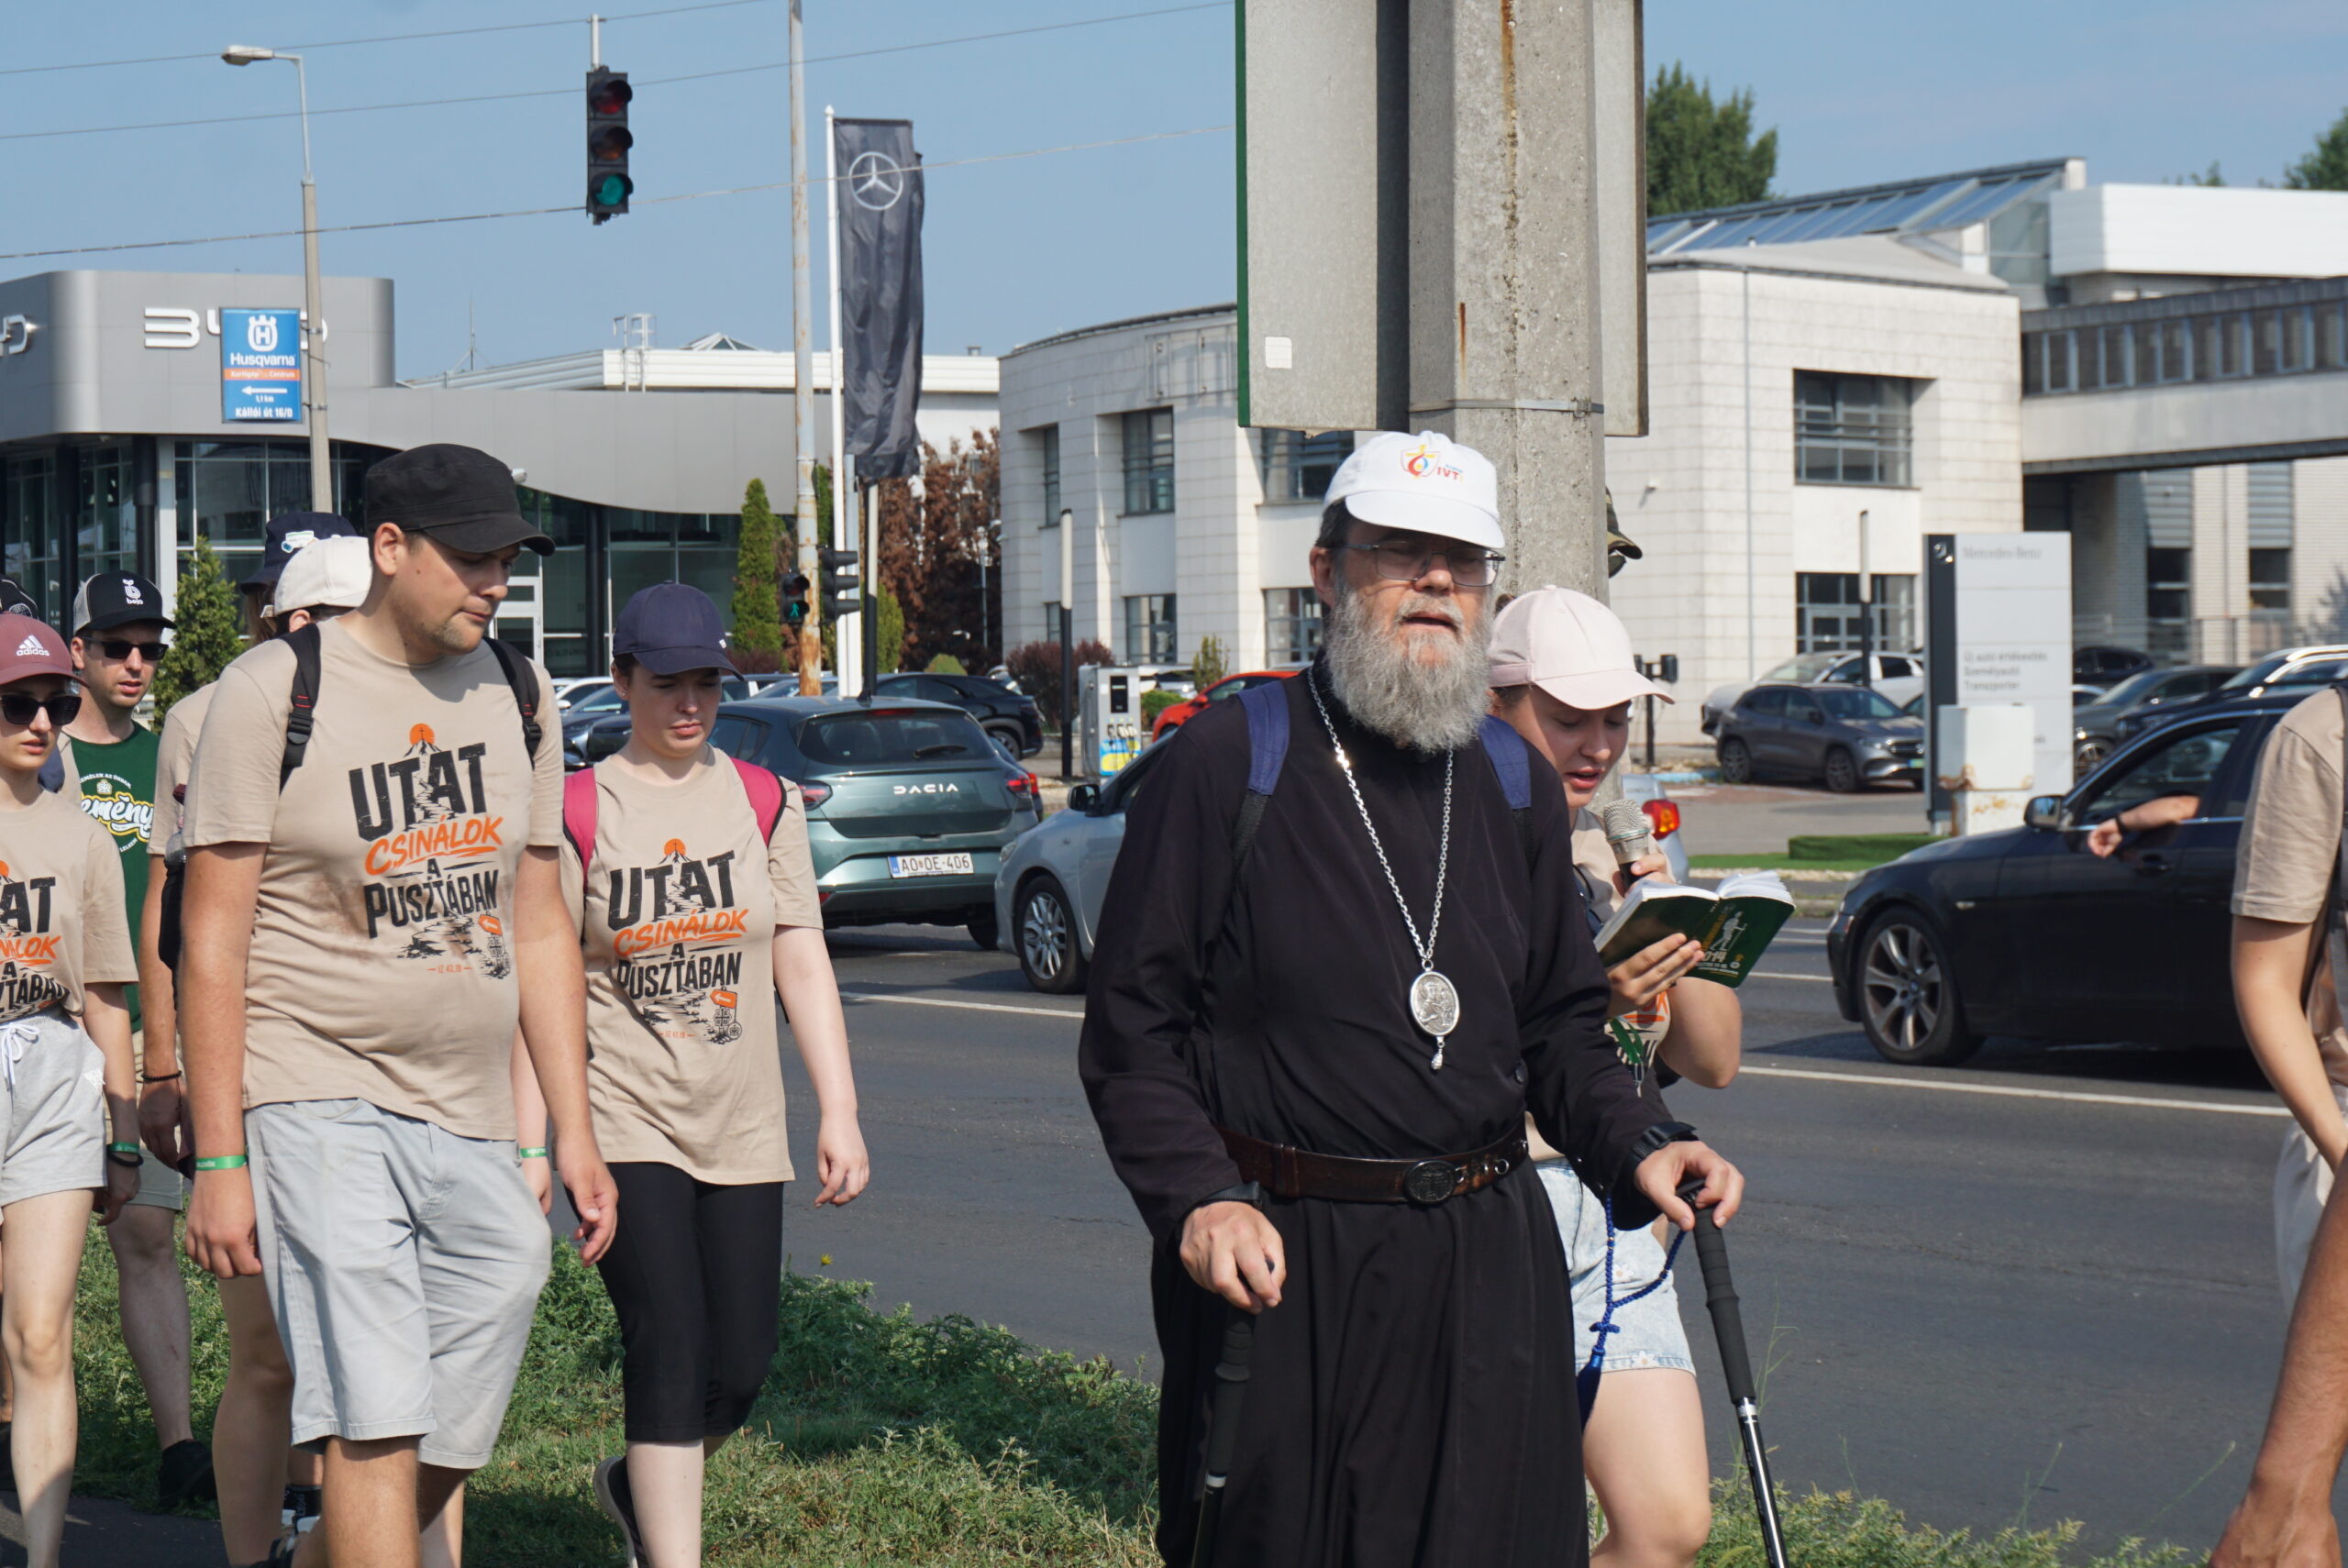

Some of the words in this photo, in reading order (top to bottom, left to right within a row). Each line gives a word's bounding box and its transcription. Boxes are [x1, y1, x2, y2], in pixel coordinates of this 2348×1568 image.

[230, 352, 295, 367] Husqvarna
[17, 647, 50, 657] adidas
[349, 742, 487, 842] UTAT
[893, 782, 958, 795] DACIA
[81, 795, 154, 839] emény
[364, 815, 504, 876] CSINÁLOK
[427, 858, 442, 879] A
[608, 850, 736, 931] UTAT
[363, 869, 500, 939] PUSZTÁBAN
[614, 909, 749, 956] CSINÁLOK
[670, 943, 685, 959] A
[3, 961, 17, 978] A
[616, 952, 742, 999] PUSZTÁBAN
